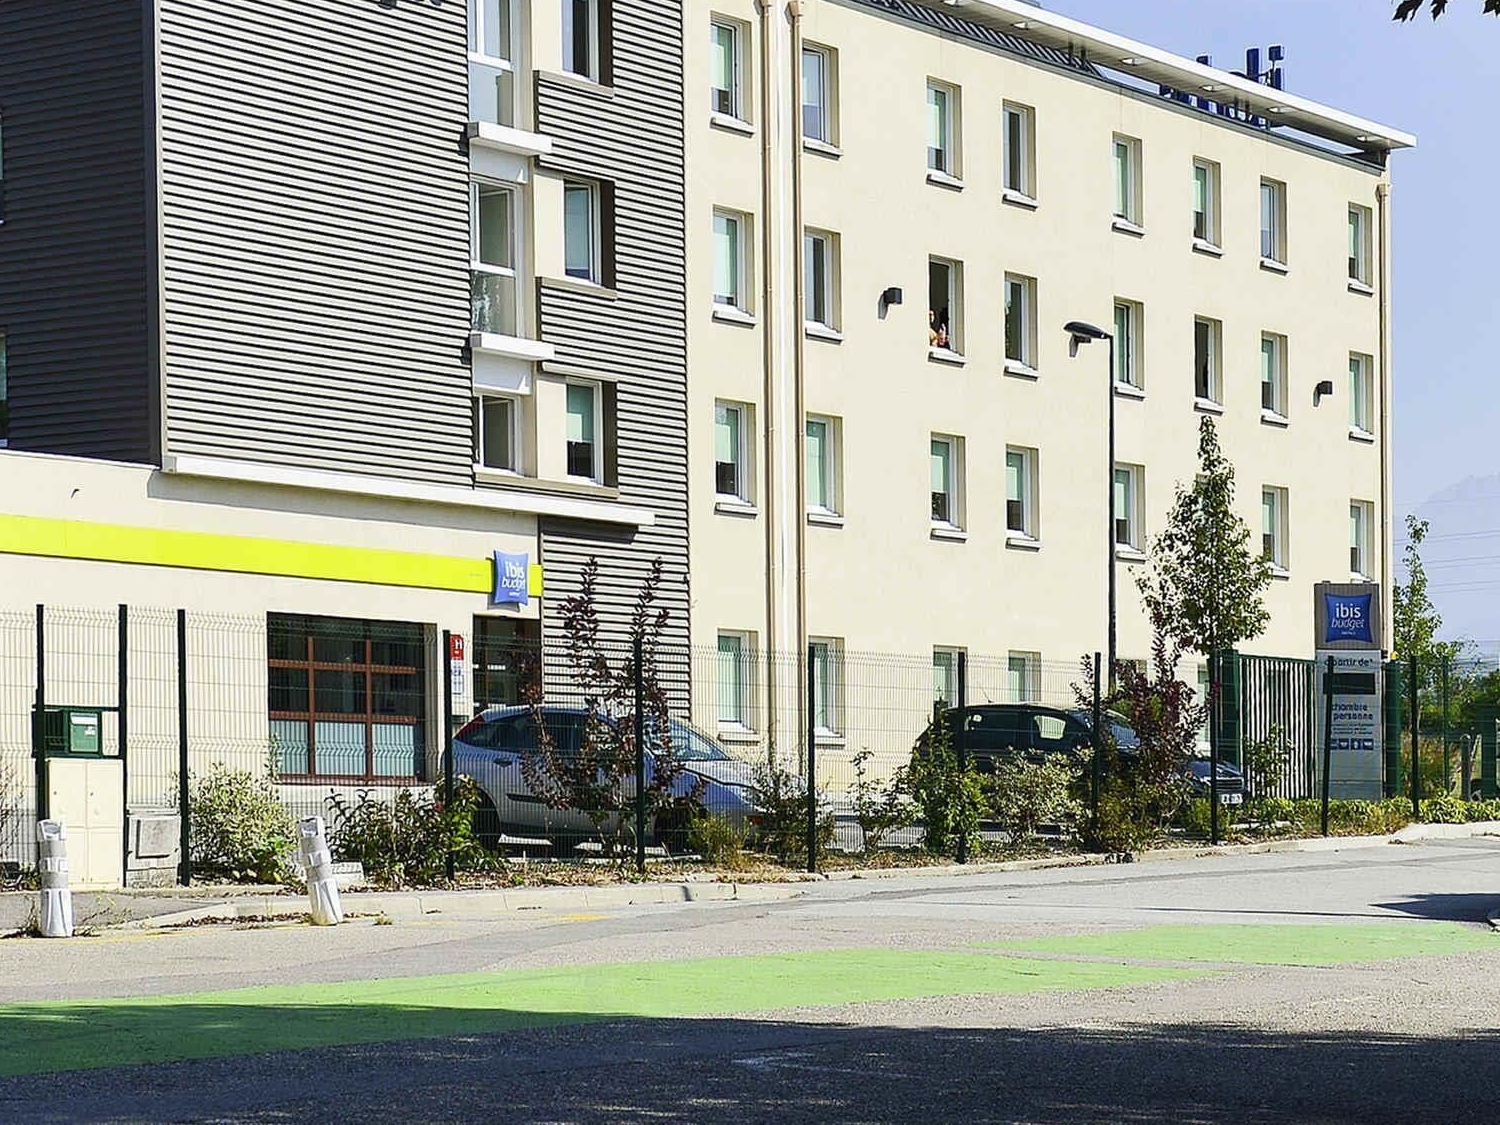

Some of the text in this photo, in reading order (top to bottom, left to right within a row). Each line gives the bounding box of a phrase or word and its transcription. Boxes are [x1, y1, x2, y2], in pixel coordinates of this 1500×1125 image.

[505, 560, 525, 579] ibis
[1335, 602, 1361, 619] ibis
[1331, 618, 1365, 631] budget
